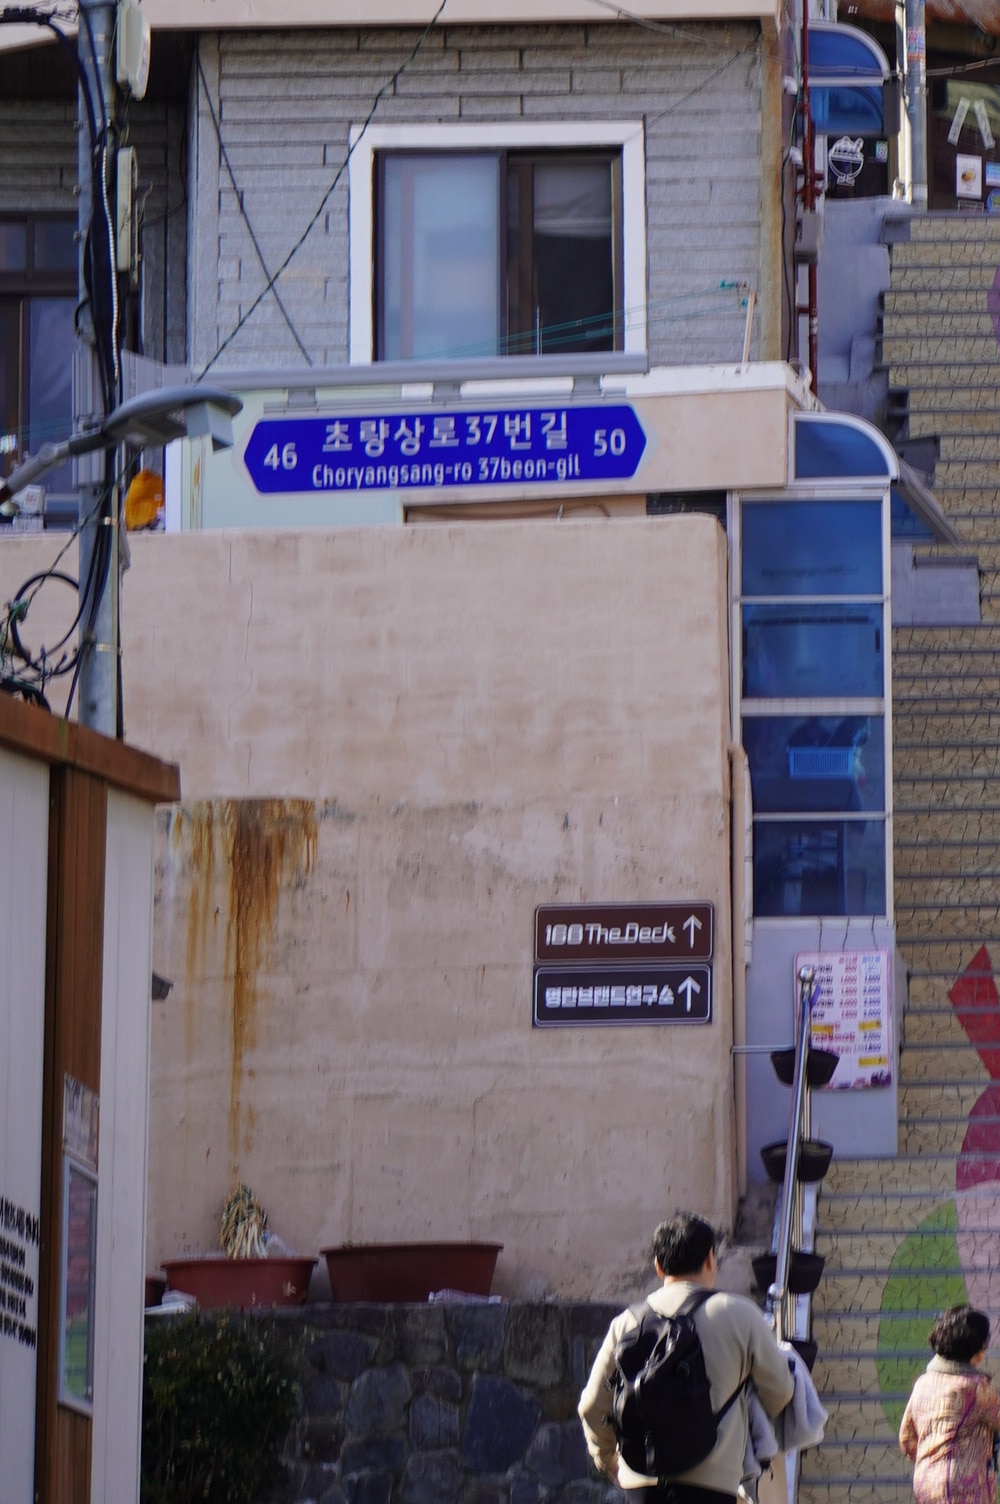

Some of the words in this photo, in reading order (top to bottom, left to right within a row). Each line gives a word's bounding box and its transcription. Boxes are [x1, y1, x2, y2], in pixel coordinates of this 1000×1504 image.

[322, 410, 568, 457] 초량상로37번길
[593, 427, 627, 457] 50
[263, 442, 298, 471] 46
[312, 460, 472, 490] Choryangsang-ro
[478, 453, 581, 481] 37beon-gil
[545, 985, 675, 1008] 명란브랜드연구소
